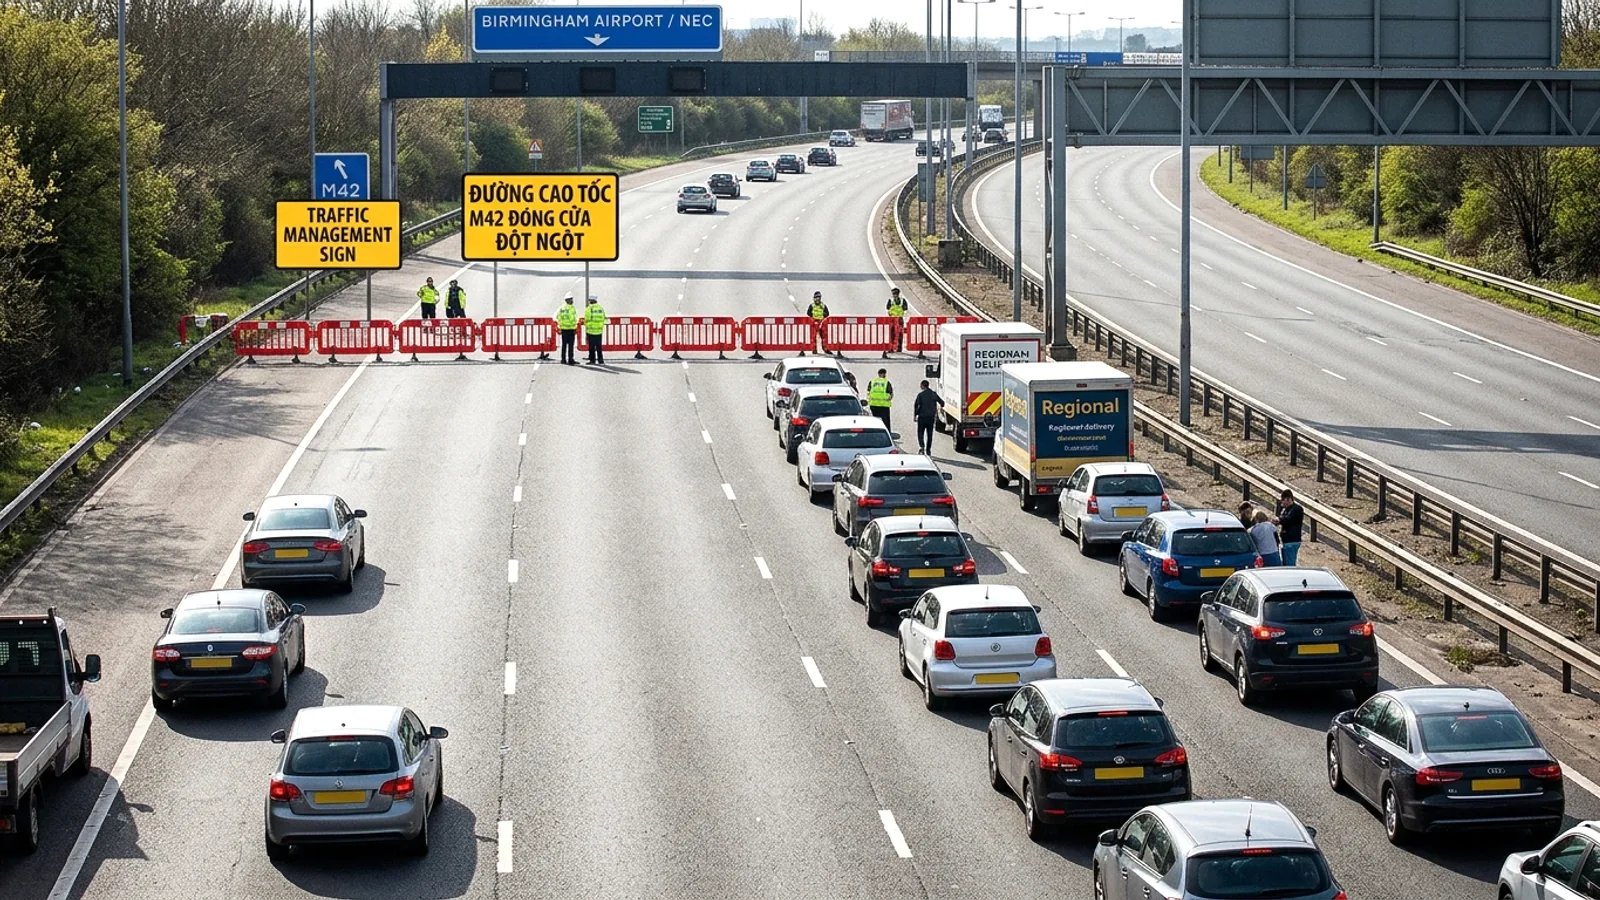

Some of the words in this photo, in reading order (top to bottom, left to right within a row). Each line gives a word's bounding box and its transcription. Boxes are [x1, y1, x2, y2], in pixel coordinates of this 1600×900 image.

[482, 14, 589, 28] BIRMINGHAM
[594, 14, 664, 28] AIRPORT
[679, 14, 713, 27] NEC
[322, 183, 360, 198] M42
[468, 181, 534, 203] ĐƯỜNG
[539, 184, 574, 203] CAO
[577, 178, 611, 203] TỐC
[307, 207, 369, 223] TRAFFIC
[469, 210, 504, 227] M42
[508, 207, 555, 227] ĐÓNG
[283, 227, 393, 243] MANAGEMENT
[495, 229, 532, 256] ĐỘT
[536, 229, 585, 256] NGỘT
[319, 246, 356, 262] SIGN
[1042, 397, 1119, 418] Regional
